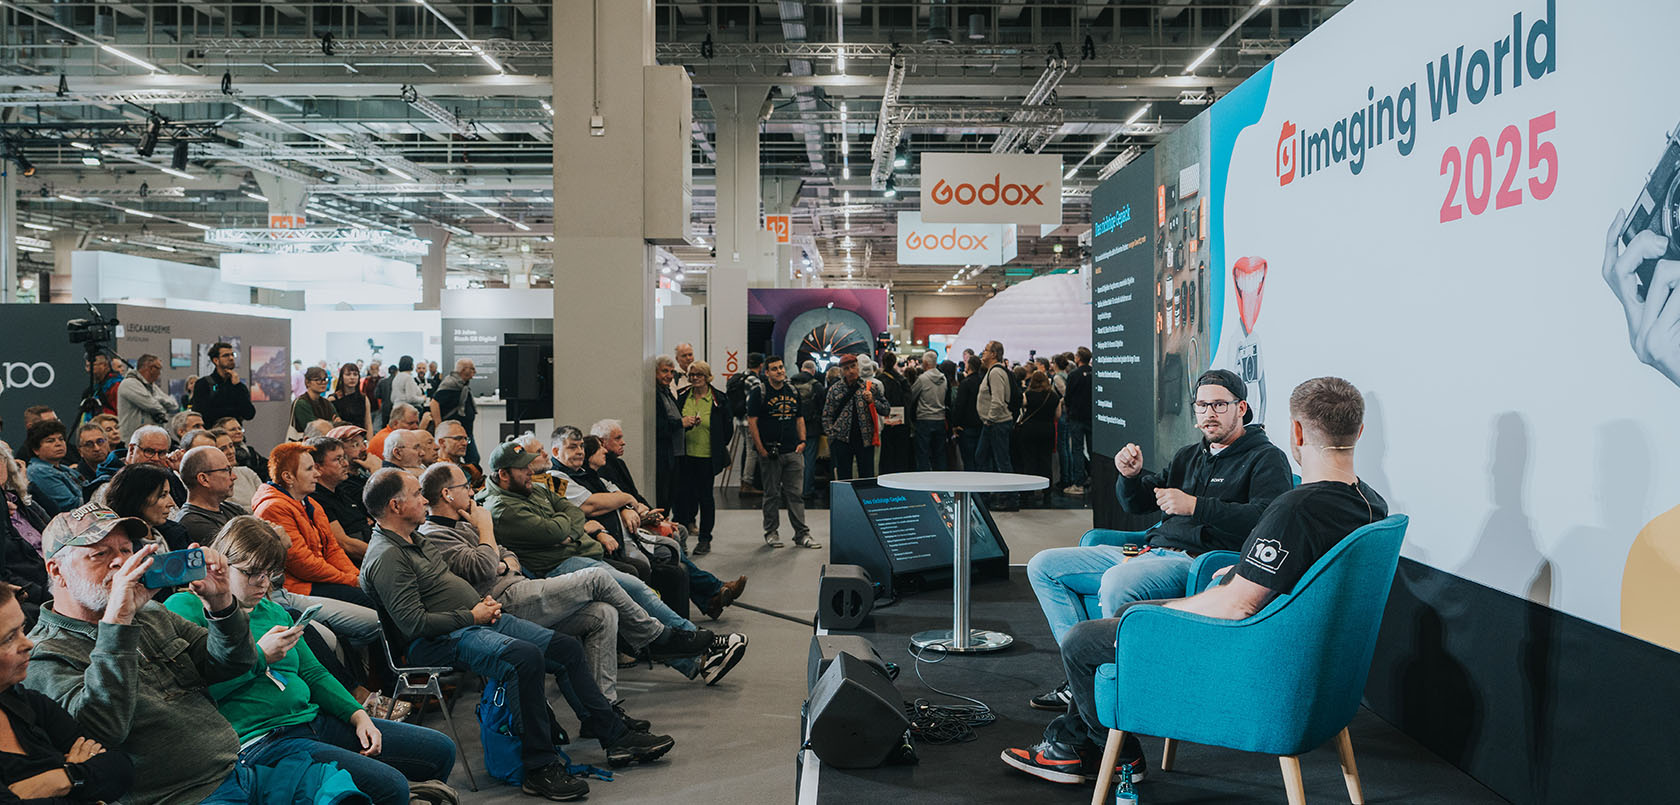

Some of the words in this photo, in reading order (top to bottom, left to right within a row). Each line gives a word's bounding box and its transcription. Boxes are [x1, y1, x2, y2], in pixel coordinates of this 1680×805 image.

[1300, 82, 1417, 178] Imaging
[1426, 0, 1556, 122] World
[1440, 110, 1559, 224] 2025
[931, 172, 1044, 206] Godox
[769, 222, 786, 237] 12
[906, 227, 989, 251] Godox
[1254, 543, 1278, 563] 10
